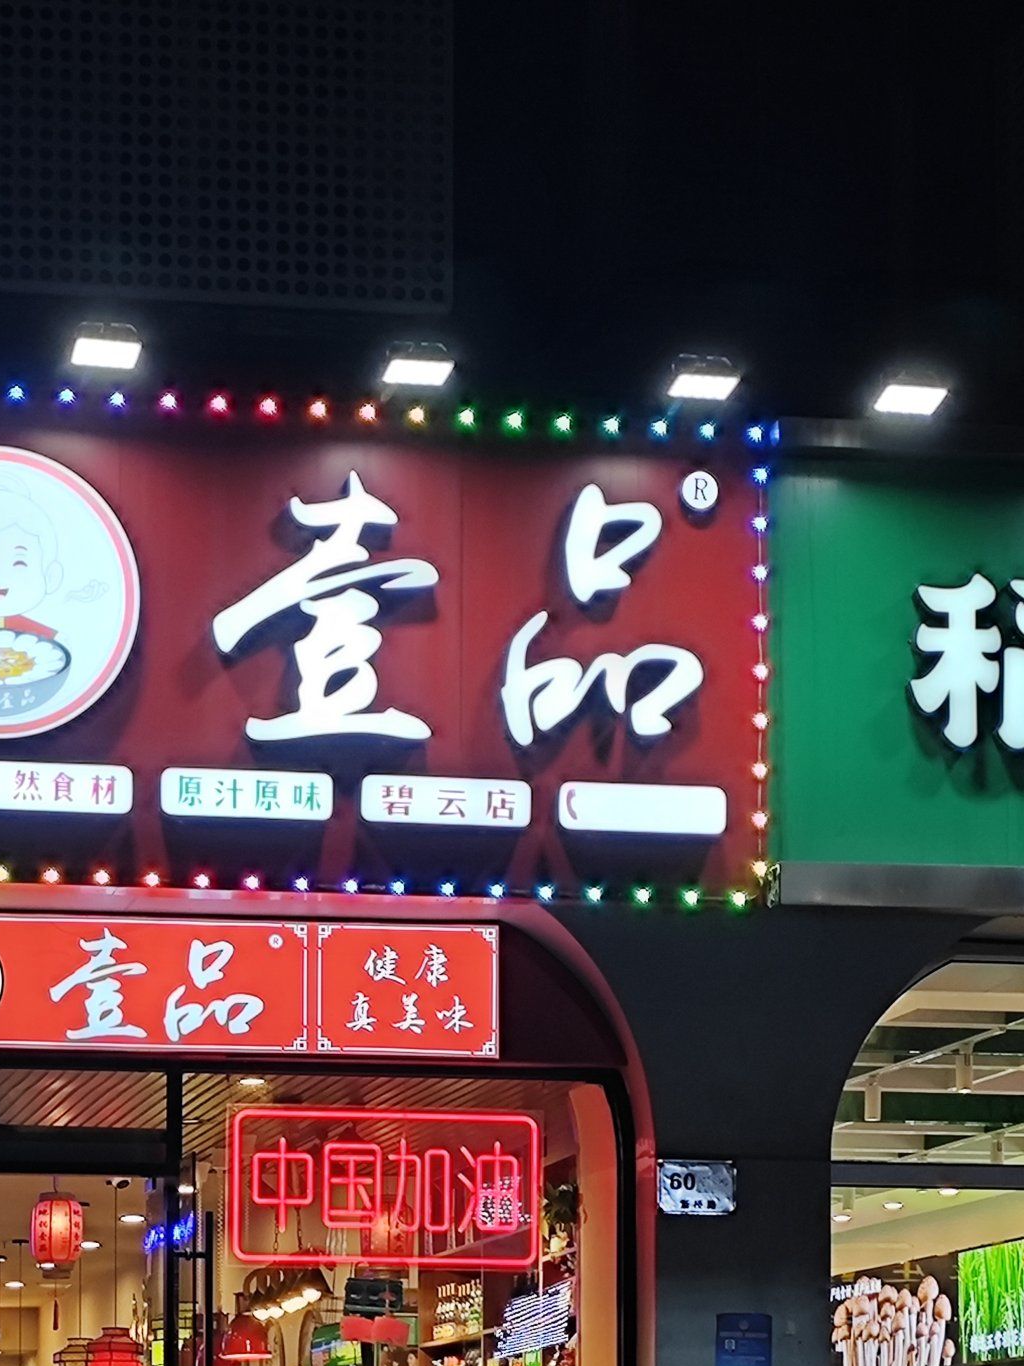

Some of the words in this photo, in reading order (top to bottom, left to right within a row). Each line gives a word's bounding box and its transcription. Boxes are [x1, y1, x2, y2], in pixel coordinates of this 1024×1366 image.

[213, 470, 704, 746] 壹品
[176, 773, 322, 813] 原汁原味
[381, 785, 517, 821] 碧云店
[48, 928, 265, 1042] 壹品
[364, 945, 449, 987] 健康
[343, 993, 475, 1034] 真美味
[252, 1136, 521, 1234] 中国加油
[670, 1172, 696, 1191] 60
